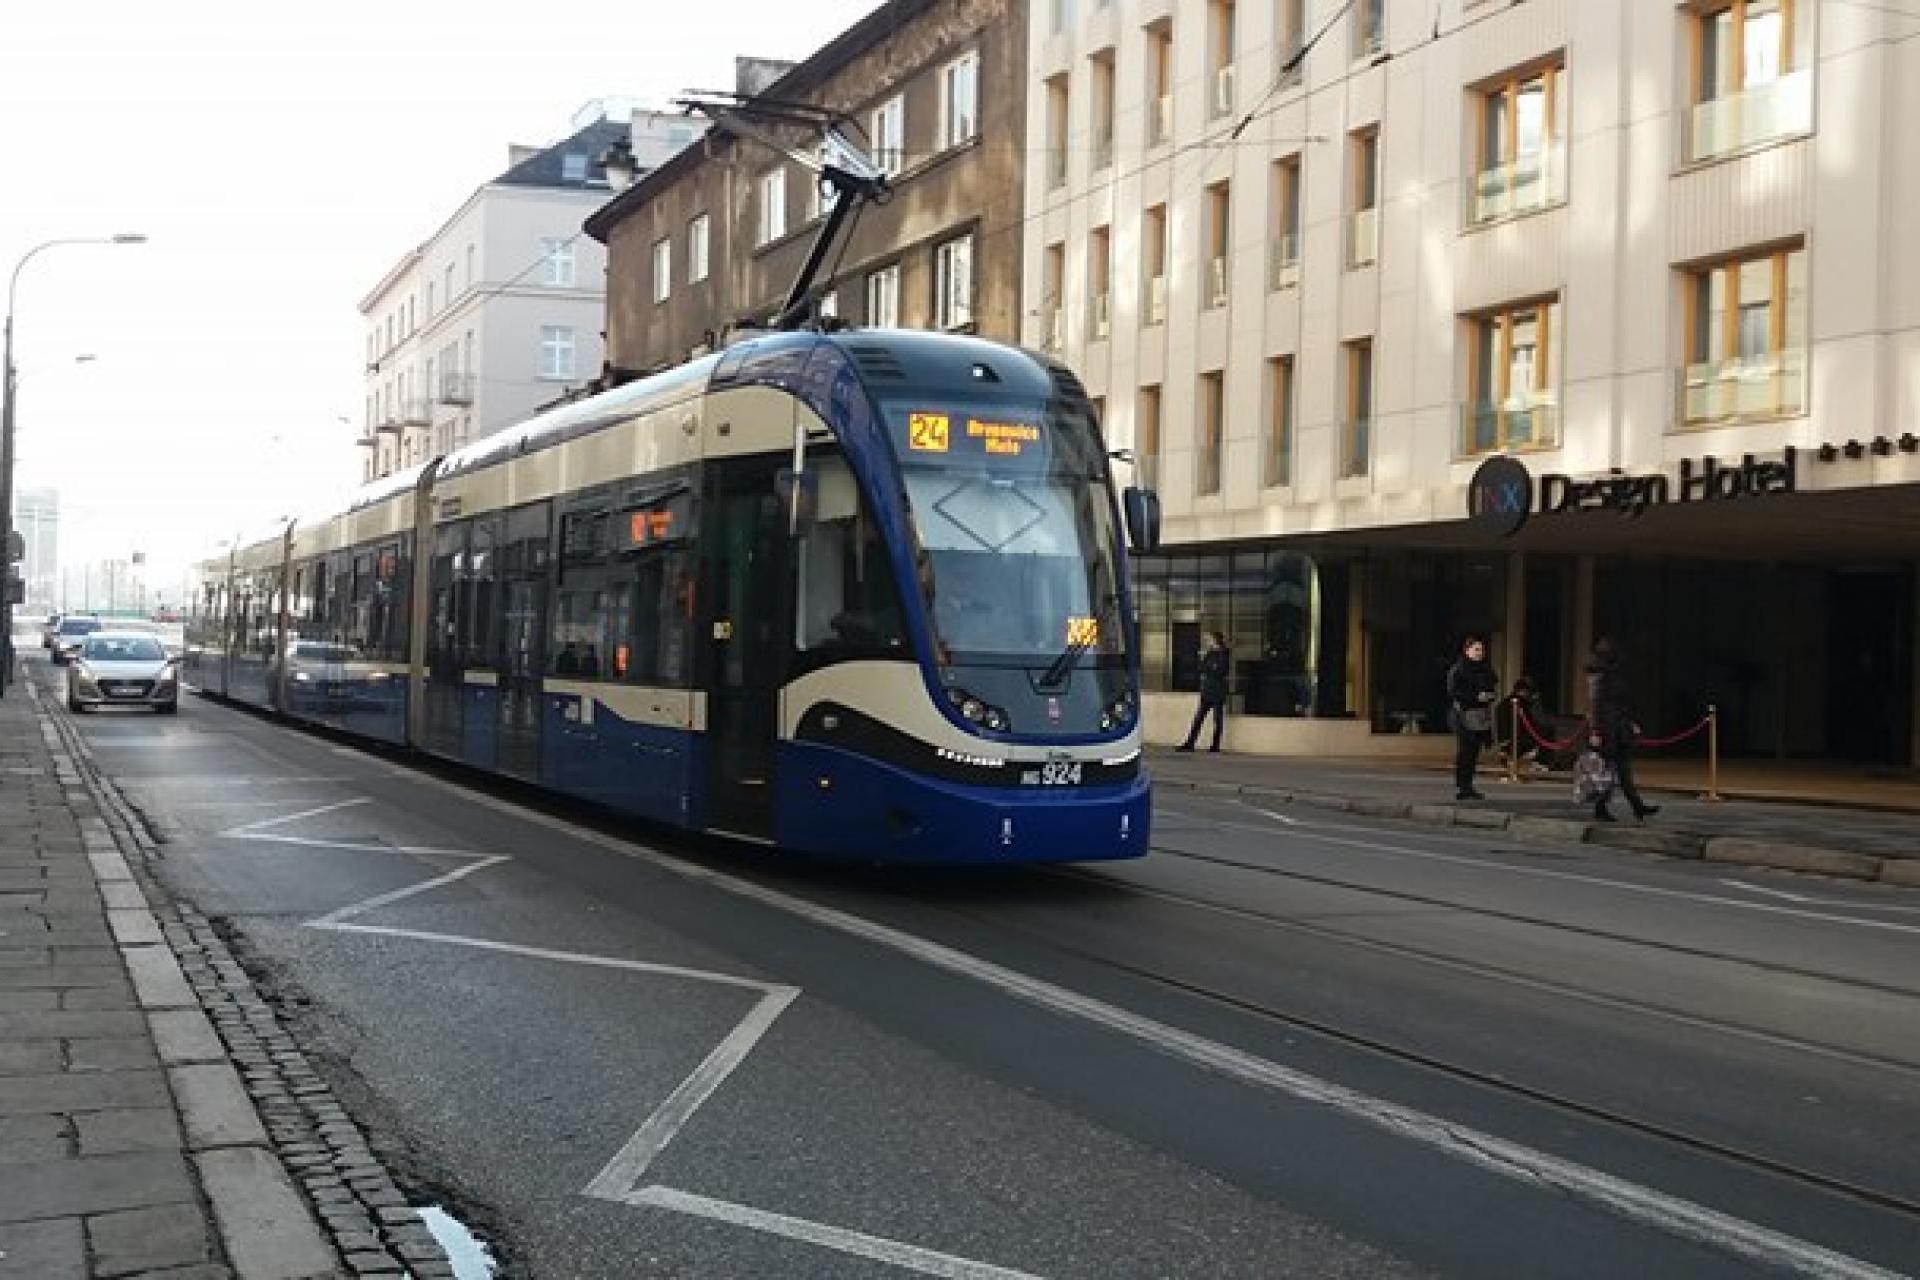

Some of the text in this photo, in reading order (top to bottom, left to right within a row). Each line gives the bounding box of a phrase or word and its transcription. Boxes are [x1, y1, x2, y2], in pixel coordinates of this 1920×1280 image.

[911, 415, 946, 447] 24
[1541, 468, 1669, 519] Design
[1680, 446, 1795, 502] Hotel
[1042, 761, 1081, 785] 924
